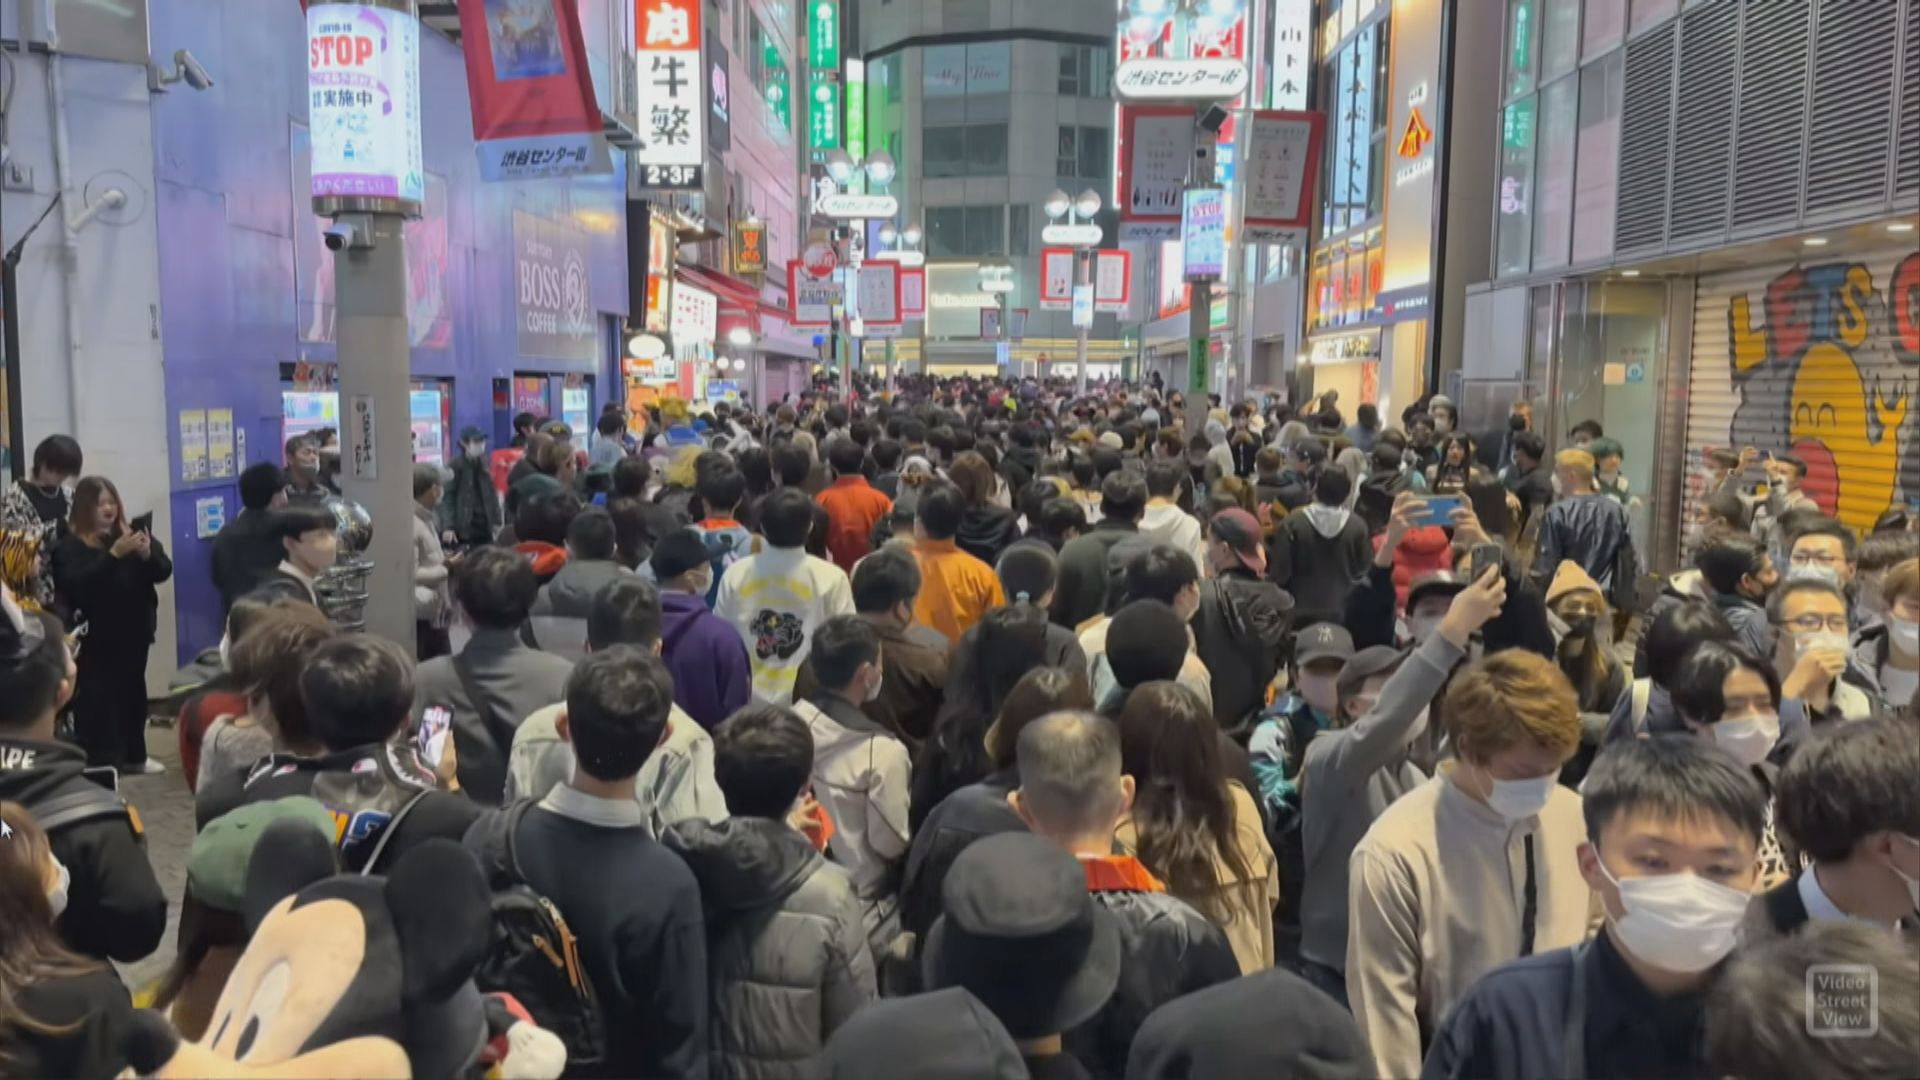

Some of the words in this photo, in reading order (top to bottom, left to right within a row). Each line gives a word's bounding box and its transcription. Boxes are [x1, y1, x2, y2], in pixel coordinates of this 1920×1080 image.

[311, 35, 374, 69] STOP
[1122, 68, 1241, 86] 渋谷センター街
[651, 56, 691, 146] 牛繁
[520, 260, 560, 310] BOSS
[527, 311, 557, 335] COFFEE
